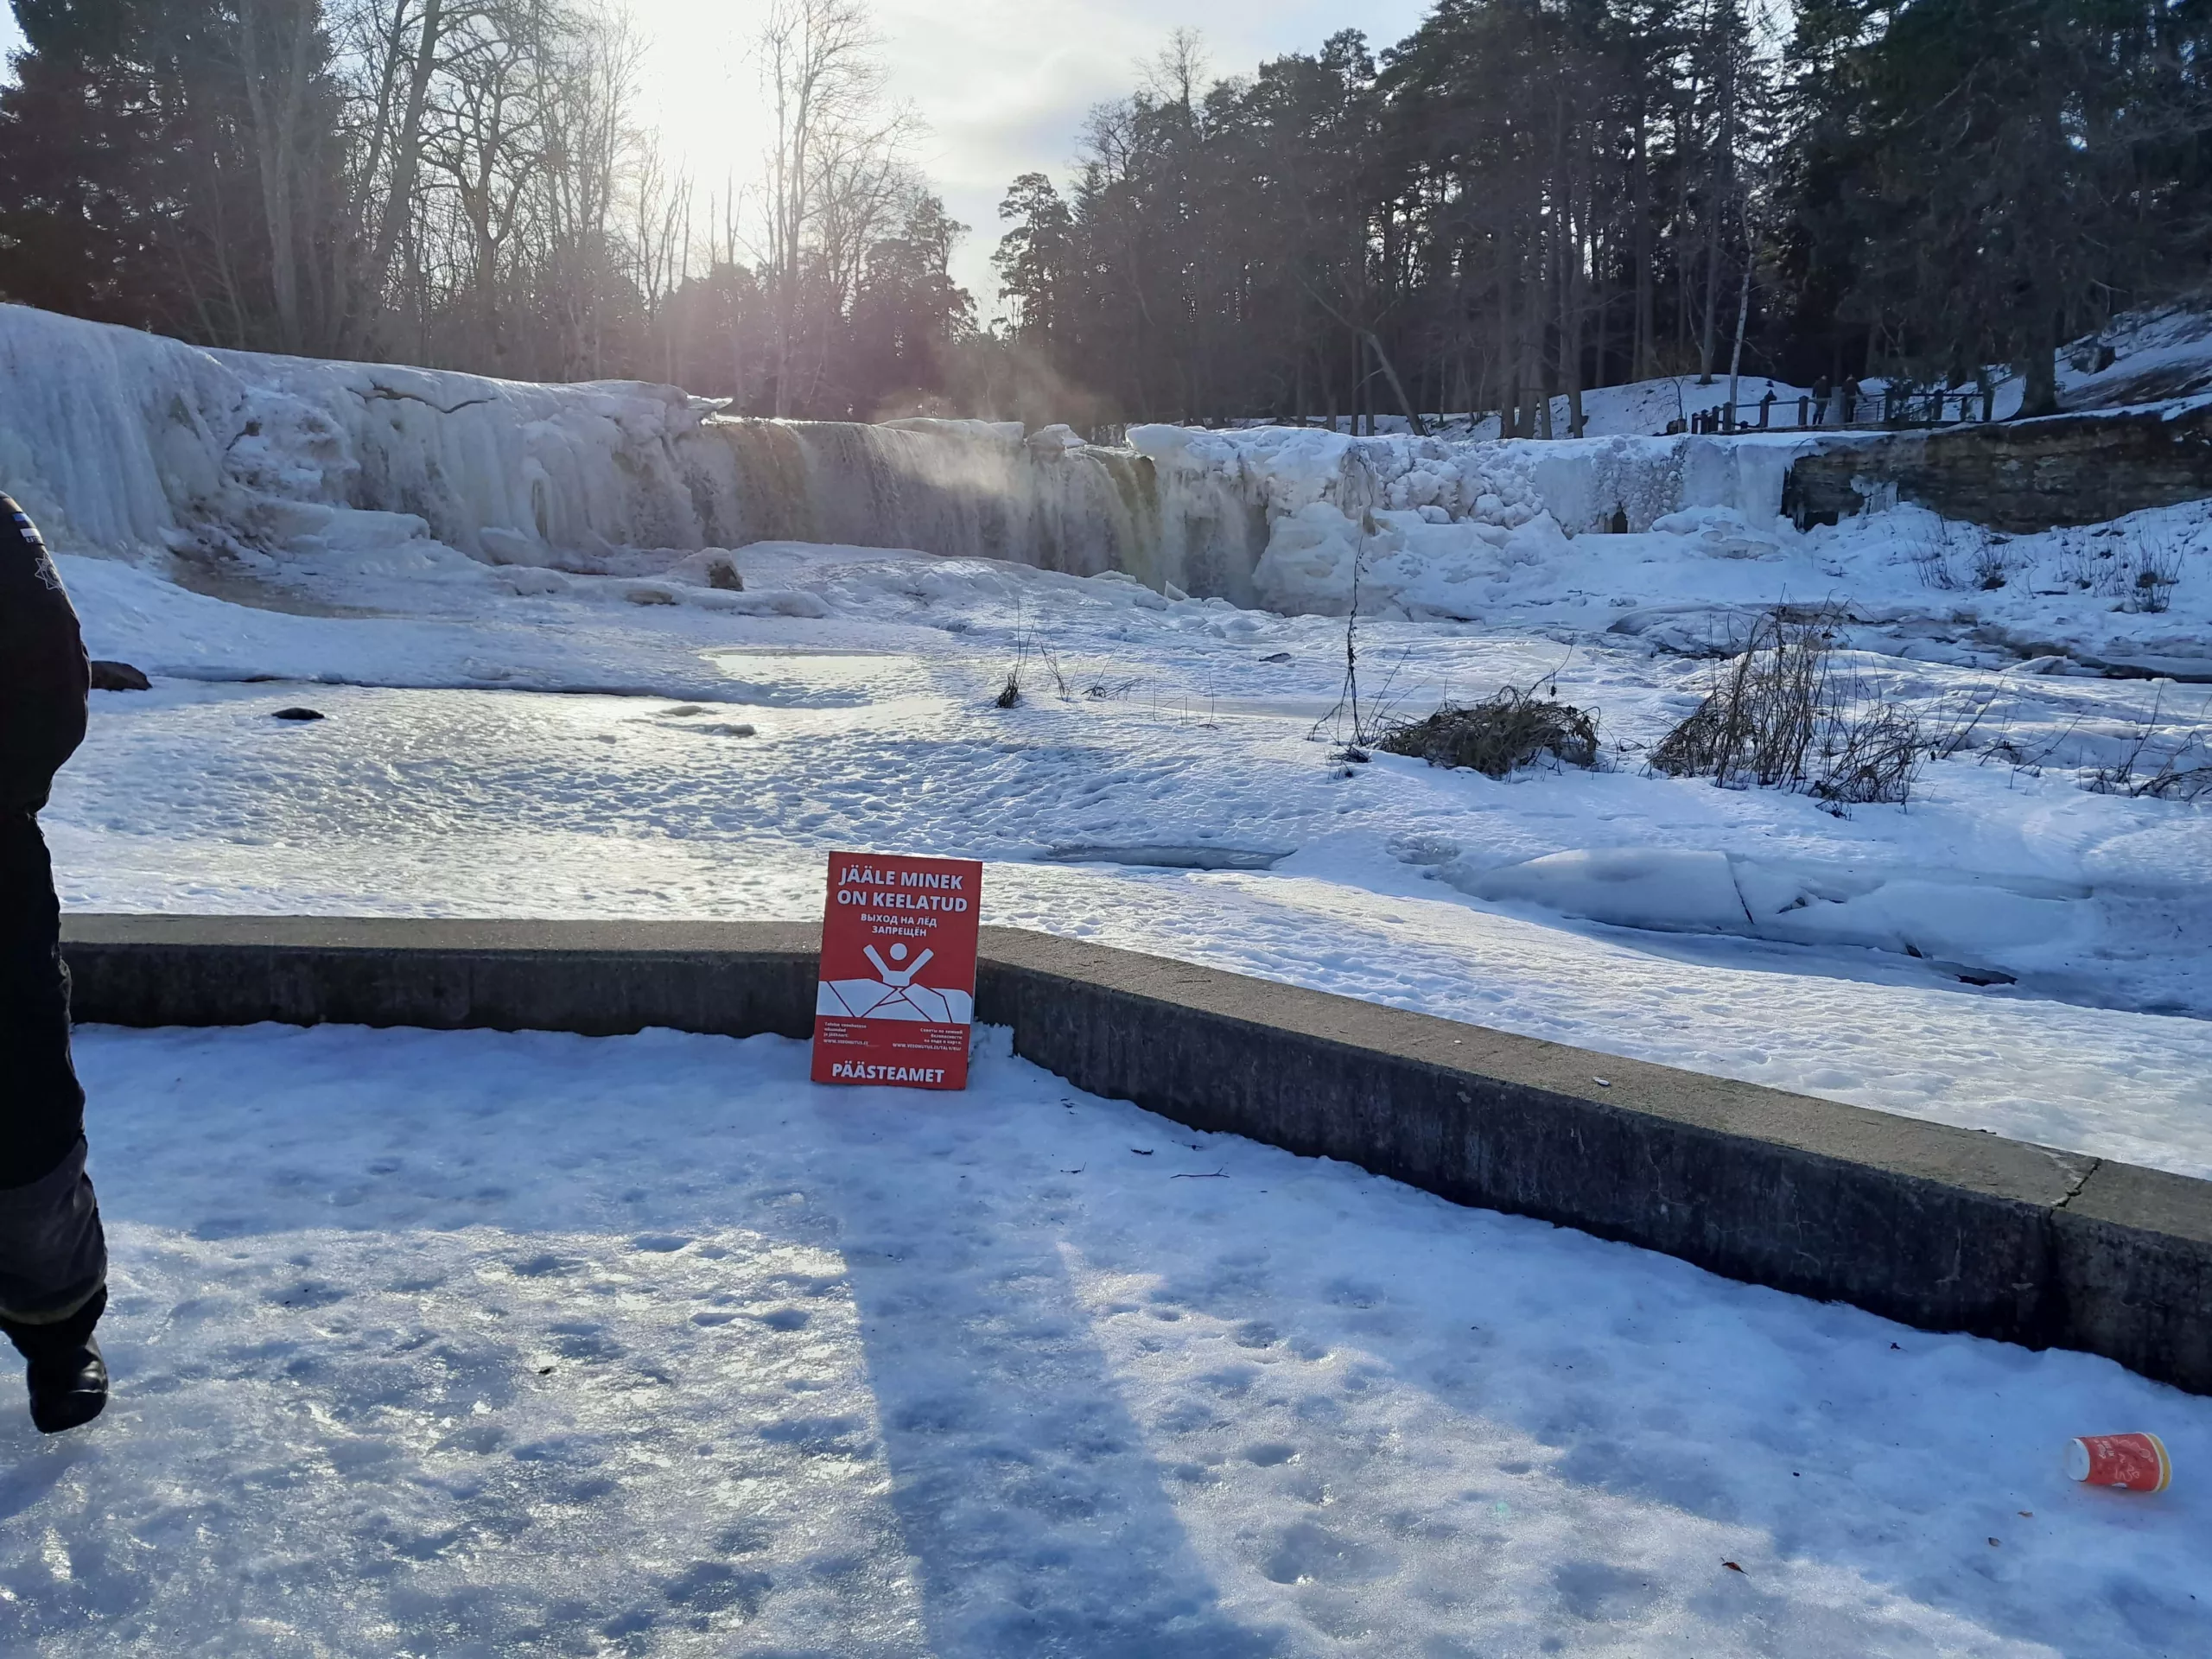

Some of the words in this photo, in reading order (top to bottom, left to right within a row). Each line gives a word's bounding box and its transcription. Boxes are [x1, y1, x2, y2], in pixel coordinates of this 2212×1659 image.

[838, 864, 895, 886] JÄÄLE
[900, 872, 963, 890] MINEK
[837, 889, 867, 906] ON
[873, 892, 968, 912] KEELATUD
[861, 913, 898, 925] ВЫХОД
[900, 916, 914, 925] НА
[917, 916, 938, 927] ЛЁД
[872, 925, 927, 938] ЗАПРЕЩЁН
[831, 1060, 944, 1083] PÄÄSTEAMET
